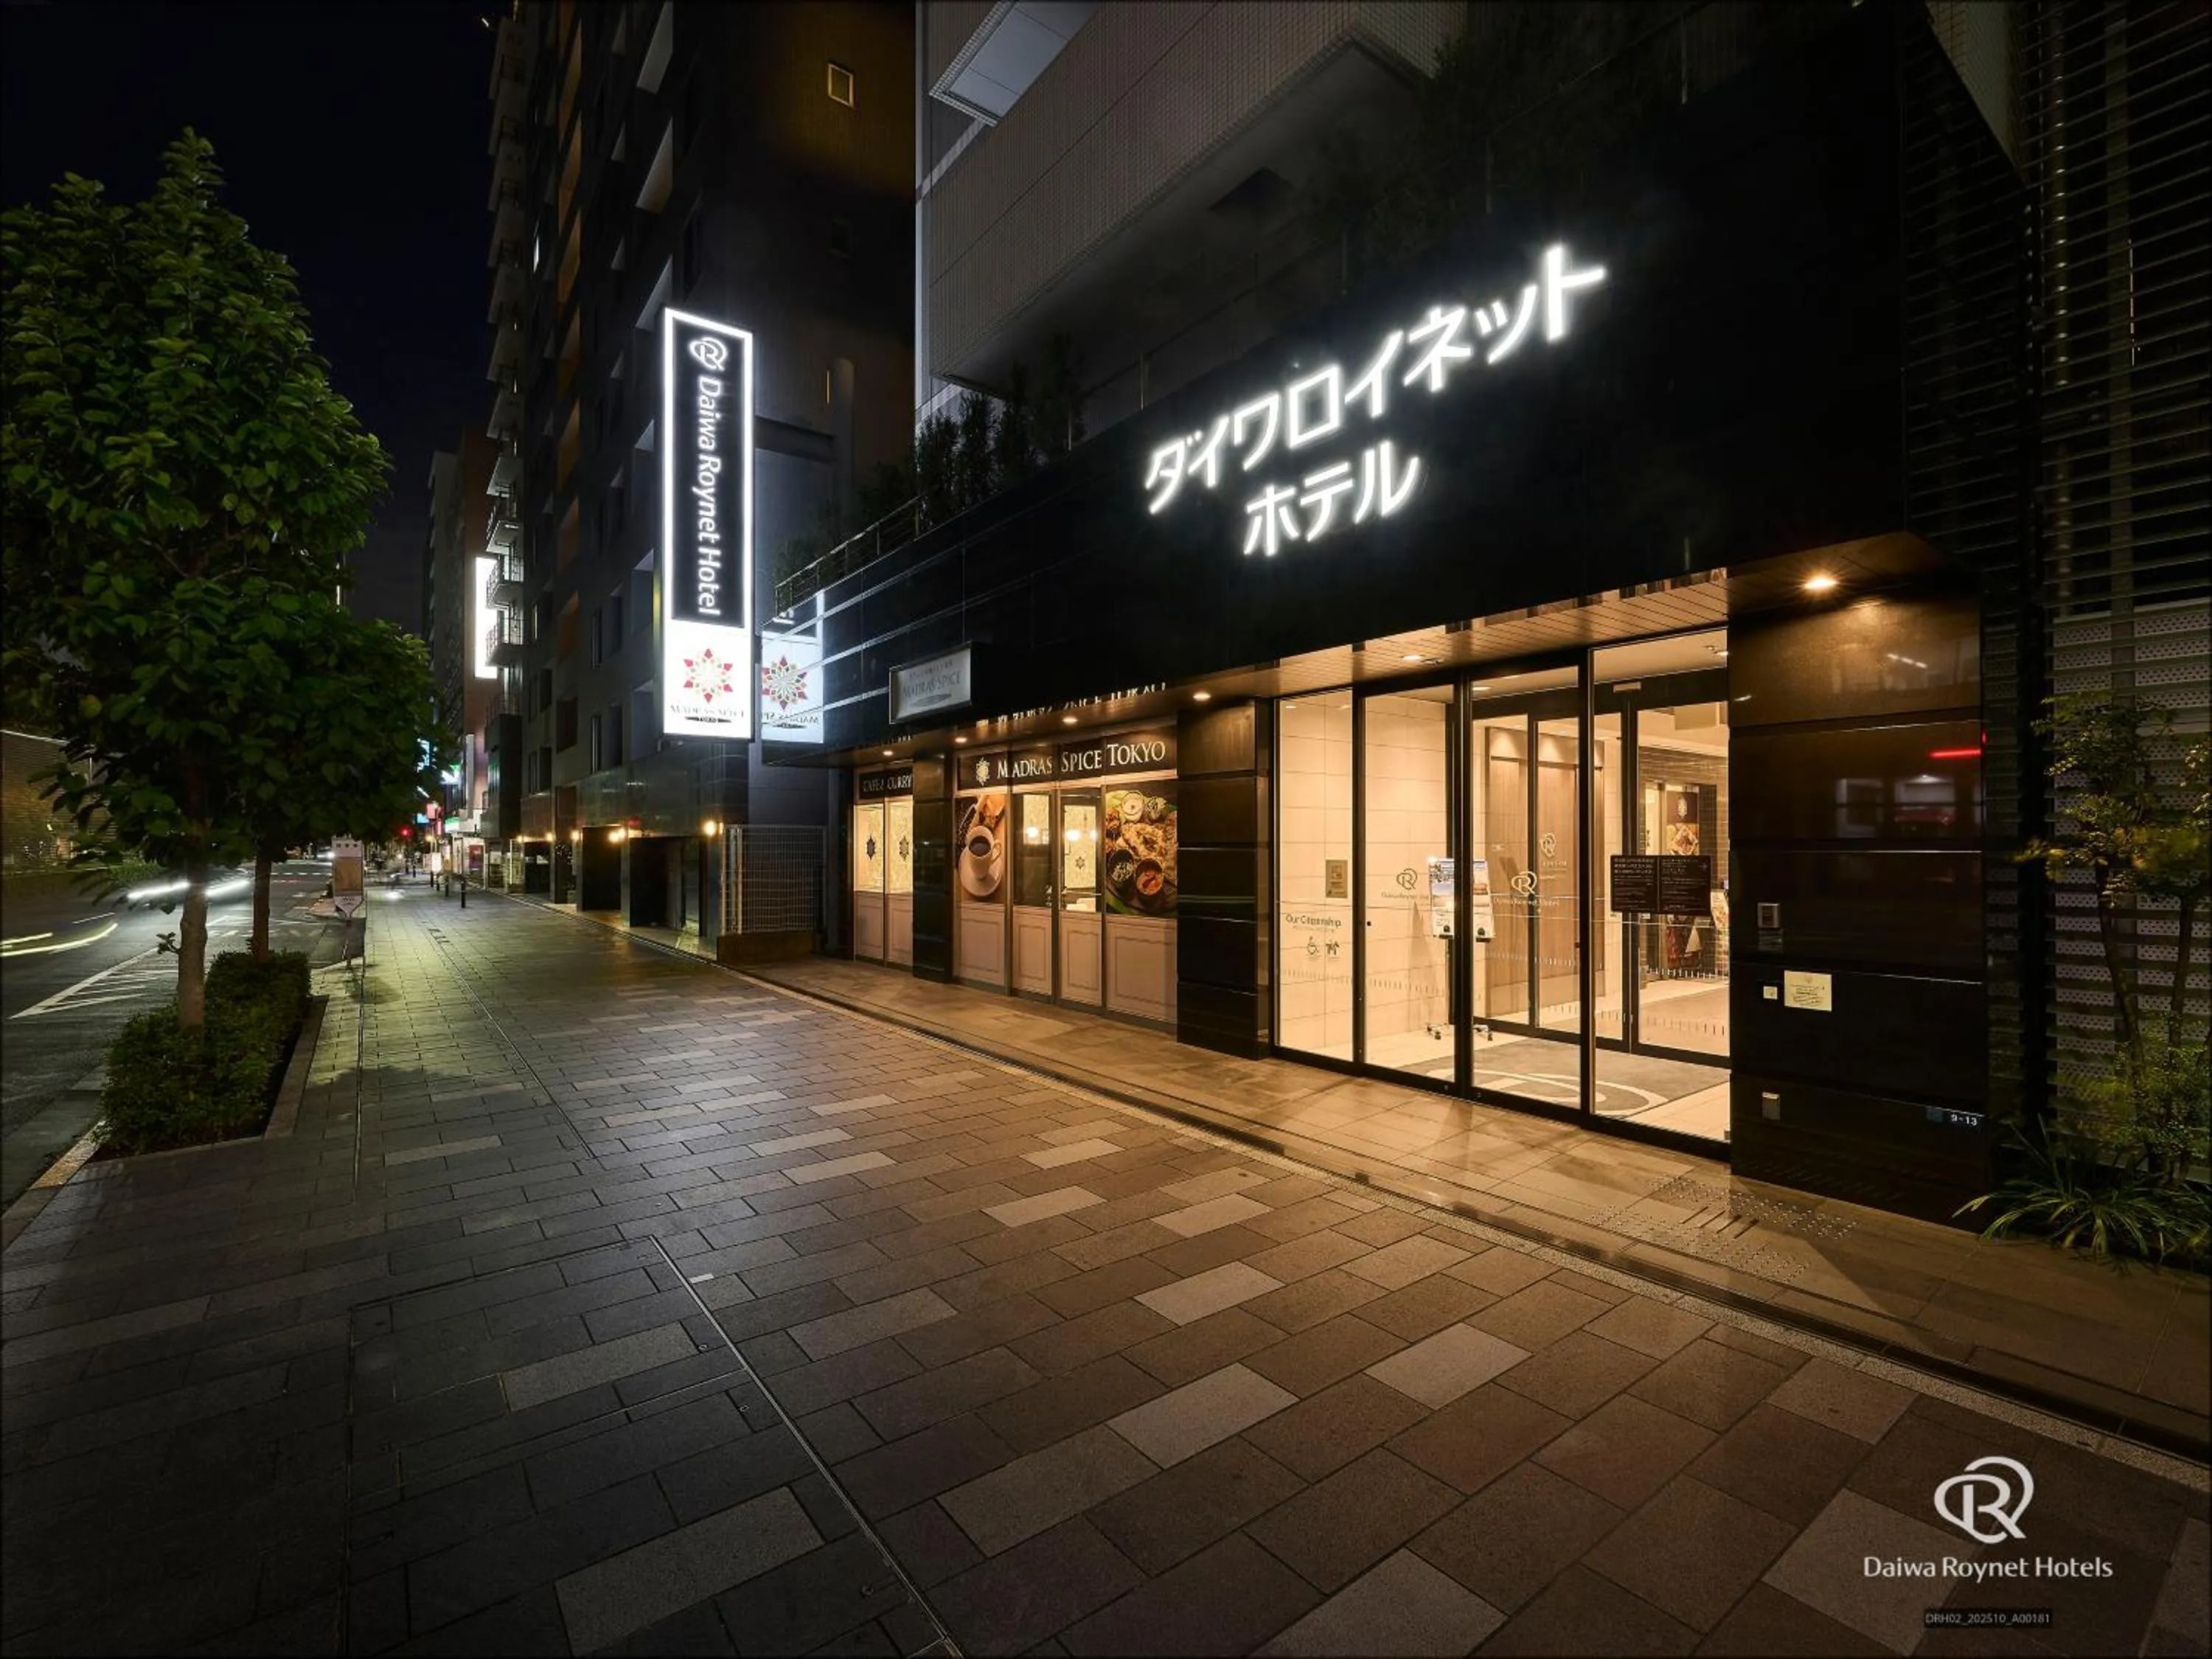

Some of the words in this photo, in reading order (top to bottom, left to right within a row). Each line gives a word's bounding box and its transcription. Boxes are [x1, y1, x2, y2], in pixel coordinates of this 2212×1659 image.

[697, 376, 722, 451] Daiwa
[1144, 243, 1606, 515] ダイワロイネット
[692, 453, 722, 546] Roynet
[1244, 440, 1420, 557] ホテル
[697, 548, 722, 616] Hotel
[997, 758, 1053, 779] MADRAS
[1062, 750, 1102, 773] SPICE
[1107, 740, 1166, 766] TOKYO
